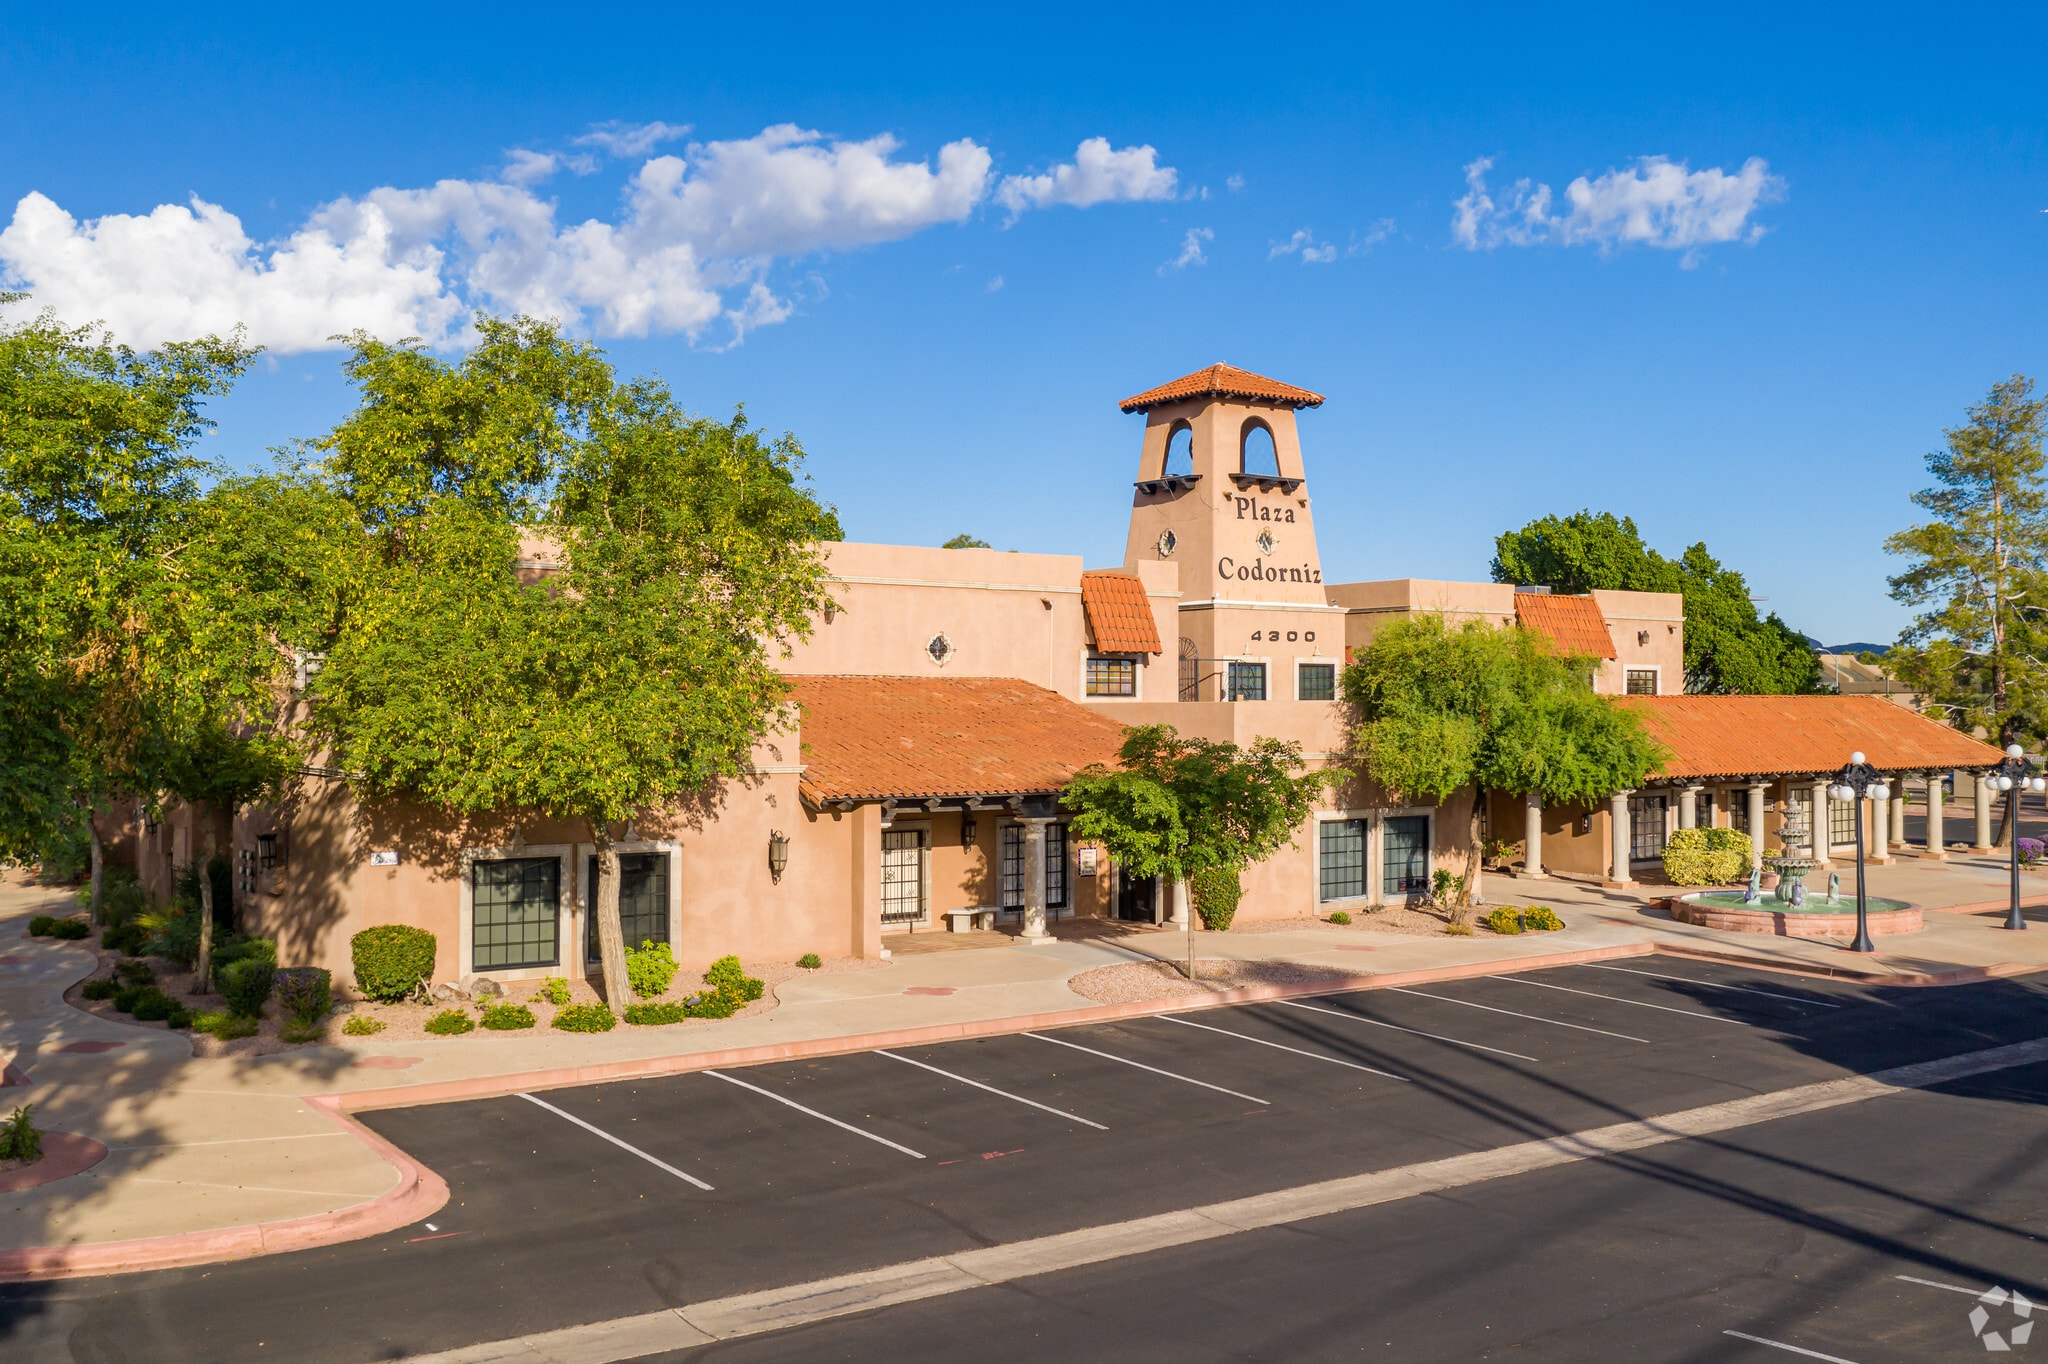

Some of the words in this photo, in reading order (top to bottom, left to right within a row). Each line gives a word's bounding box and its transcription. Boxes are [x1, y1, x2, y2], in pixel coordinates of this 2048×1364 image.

[1234, 496, 1296, 524] Plaza
[1218, 556, 1322, 584] Codorniz
[1251, 630, 1316, 642] 4300
